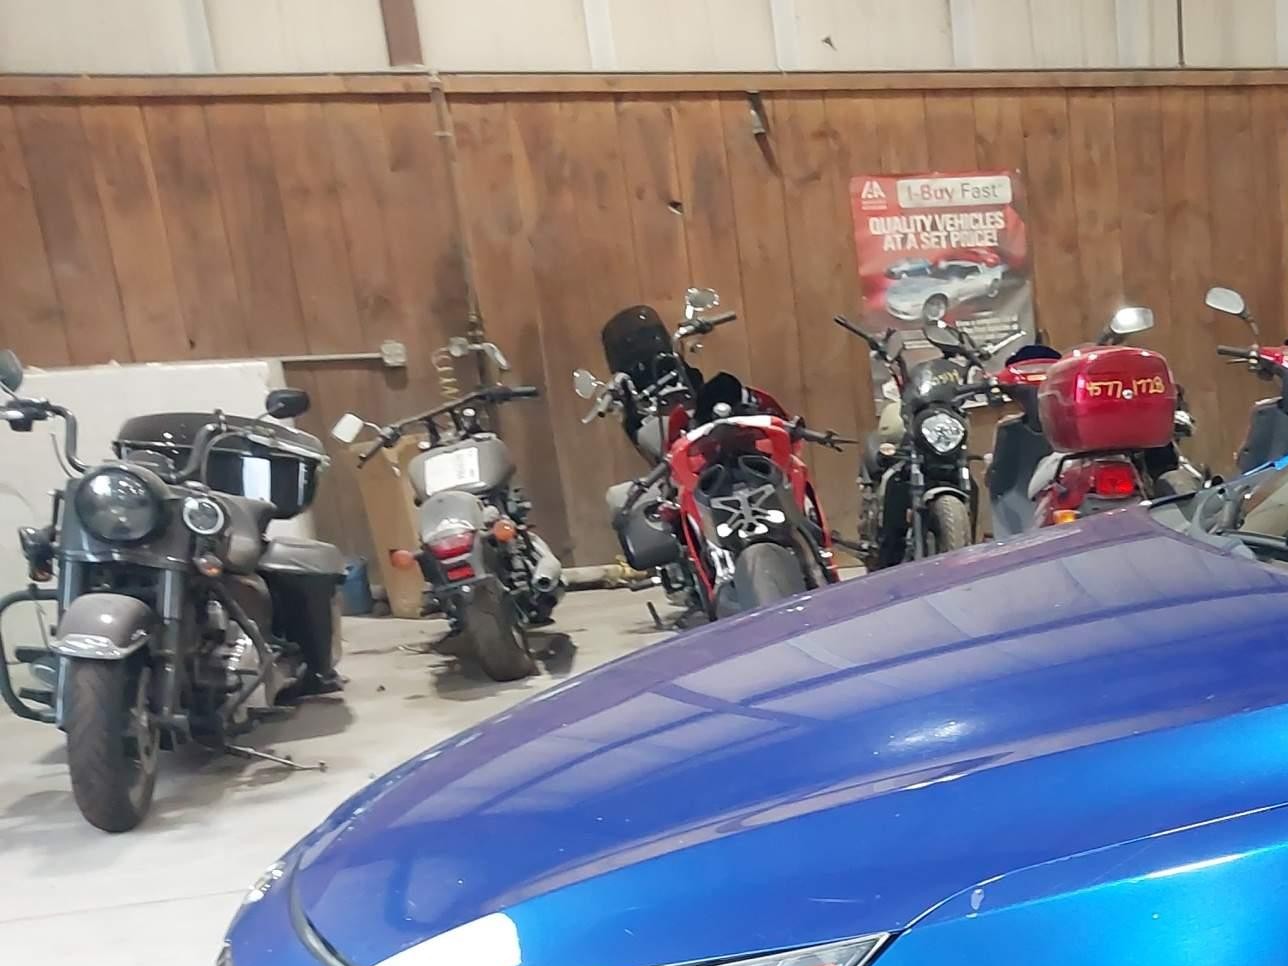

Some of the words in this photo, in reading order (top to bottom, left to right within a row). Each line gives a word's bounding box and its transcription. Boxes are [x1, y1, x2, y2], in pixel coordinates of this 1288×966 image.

[907, 184, 954, 201] I-Buy
[869, 214, 933, 235] QUALITY
[934, 211, 1005, 232] VEHICLES
[883, 234, 904, 250] AT
[905, 233, 918, 250] A
[920, 232, 949, 248] SET
[951, 229, 999, 247] PRICE!
